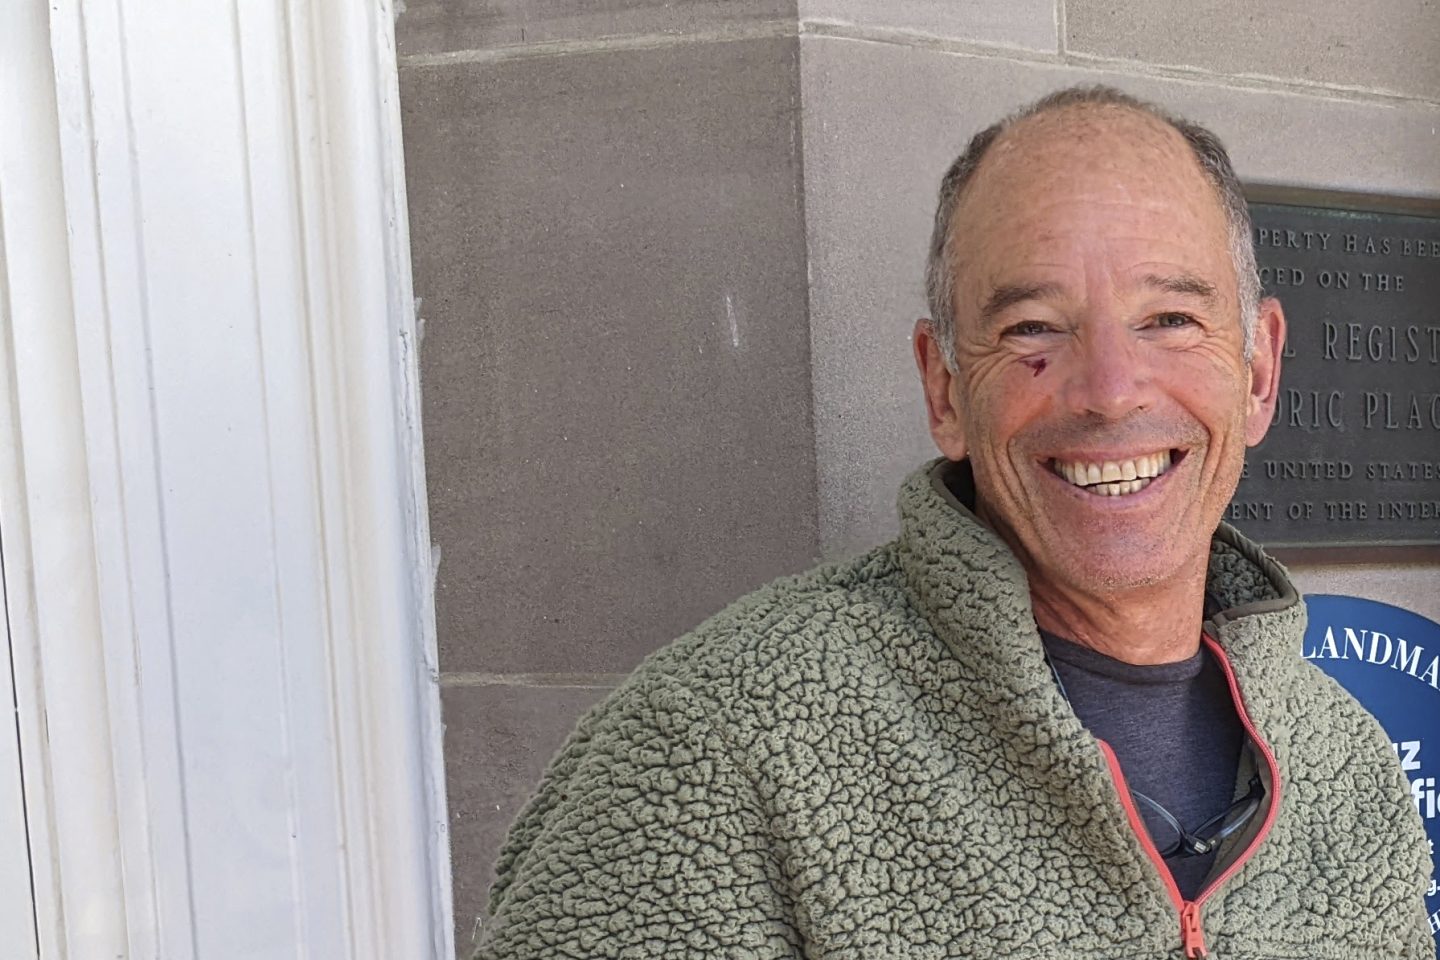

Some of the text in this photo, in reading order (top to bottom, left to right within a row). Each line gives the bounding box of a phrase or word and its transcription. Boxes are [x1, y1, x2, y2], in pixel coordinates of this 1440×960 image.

[1257, 227, 1331, 250] PERTY
[1345, 233, 1391, 255] HAS
[1259, 267, 1404, 292] CED ON THE
[1264, 460, 1354, 480] UNITED
[1231, 502, 1274, 520] ENT
[1287, 501, 1313, 520] OF
[1325, 501, 1368, 520] THE
